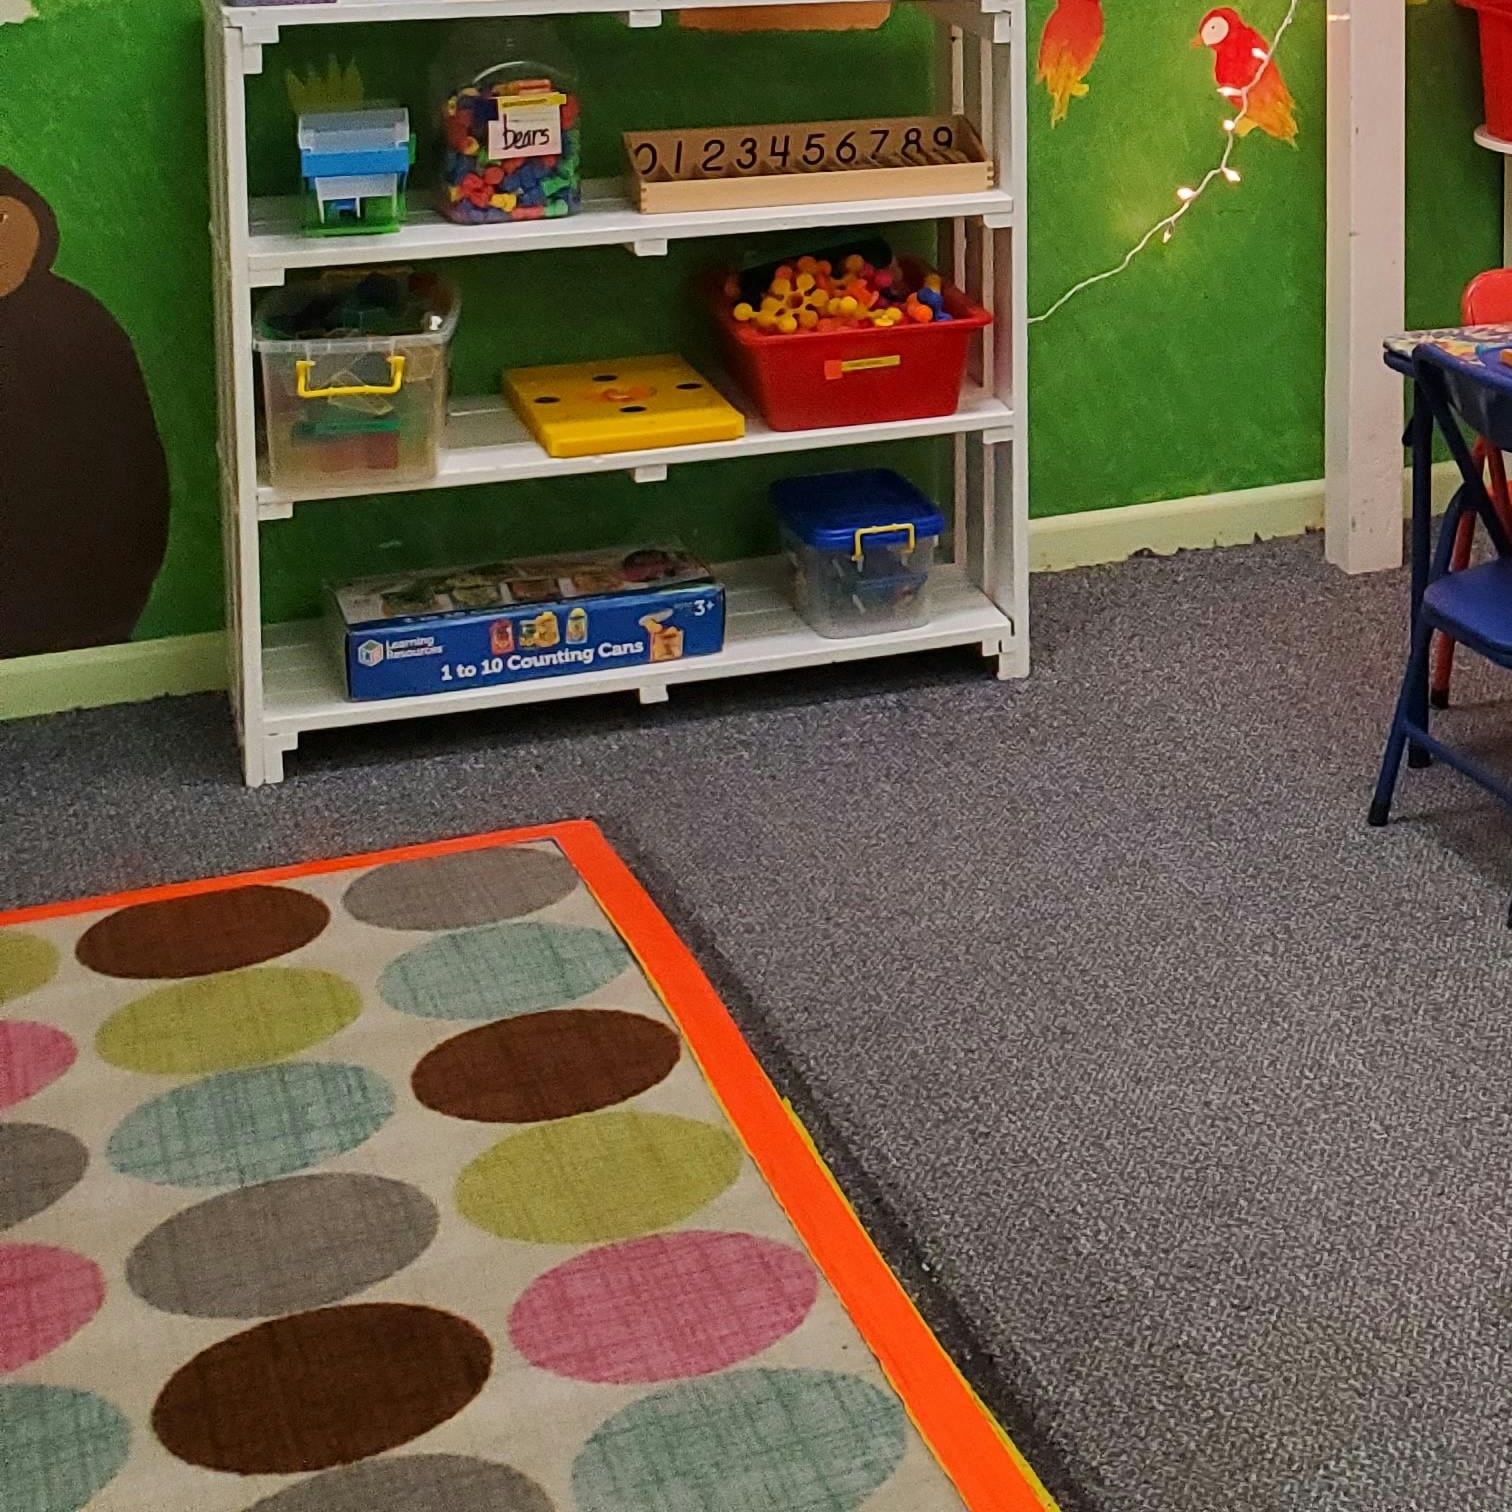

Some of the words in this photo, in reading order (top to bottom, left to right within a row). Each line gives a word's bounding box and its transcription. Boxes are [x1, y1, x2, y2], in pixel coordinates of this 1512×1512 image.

[502, 113, 549, 150] bears
[693, 598, 715, 616] 3+
[441, 664, 452, 681] 1
[456, 664, 477, 679] to
[481, 657, 503, 675] 10
[507, 647, 595, 670] Counting
[598, 640, 644, 658] Cans
